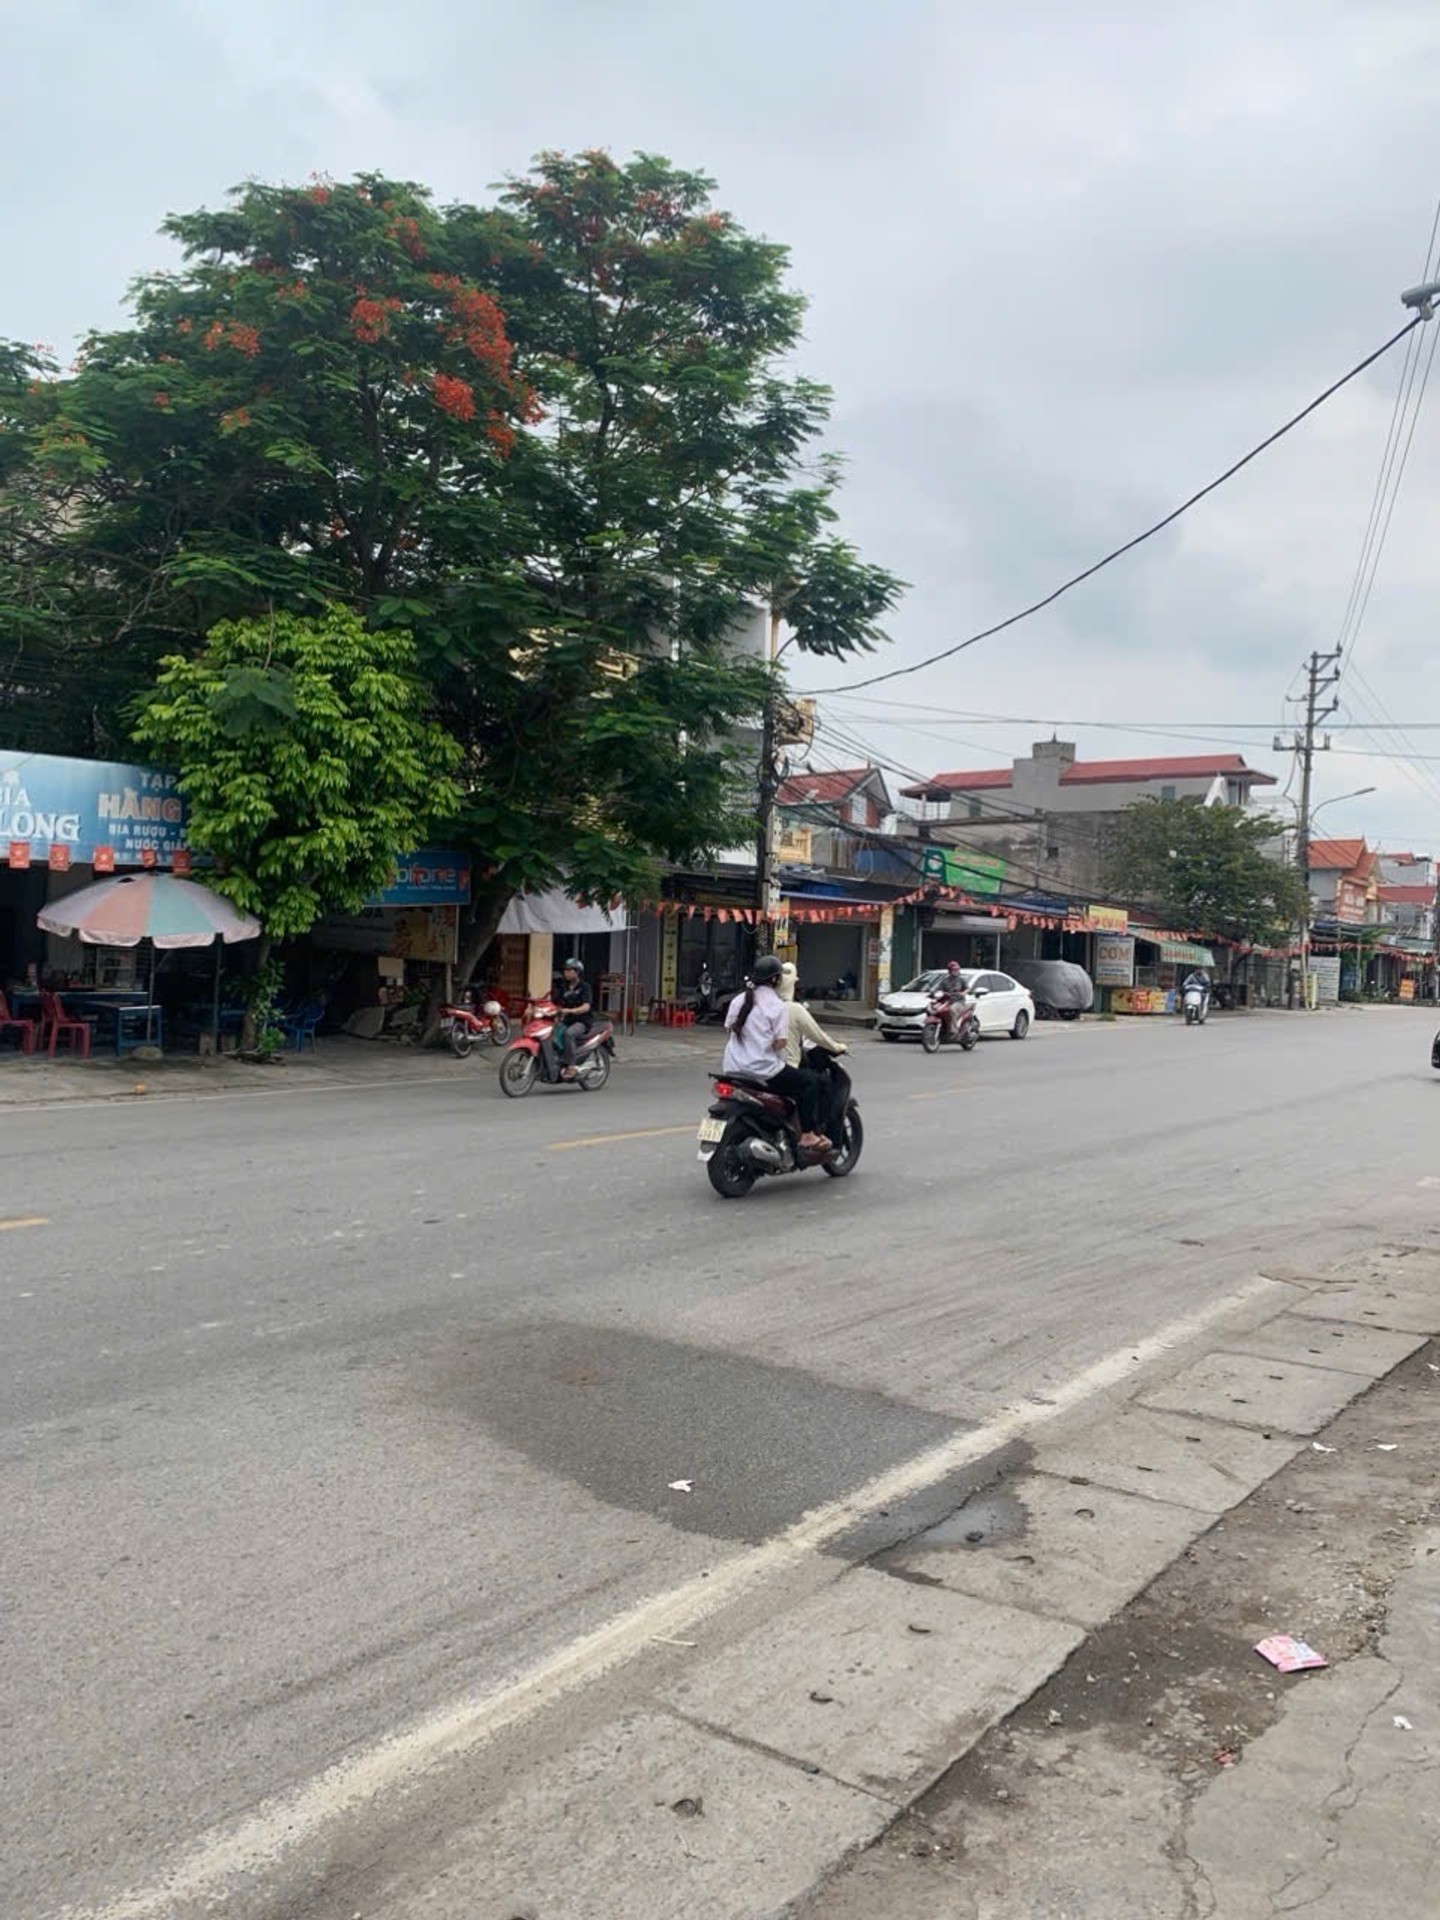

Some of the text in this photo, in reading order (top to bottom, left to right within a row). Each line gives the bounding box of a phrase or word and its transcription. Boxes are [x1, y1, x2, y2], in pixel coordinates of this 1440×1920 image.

[140, 771, 178, 792] TẠP
[0, 787, 31, 807] IA
[108, 823, 130, 836] BIA
